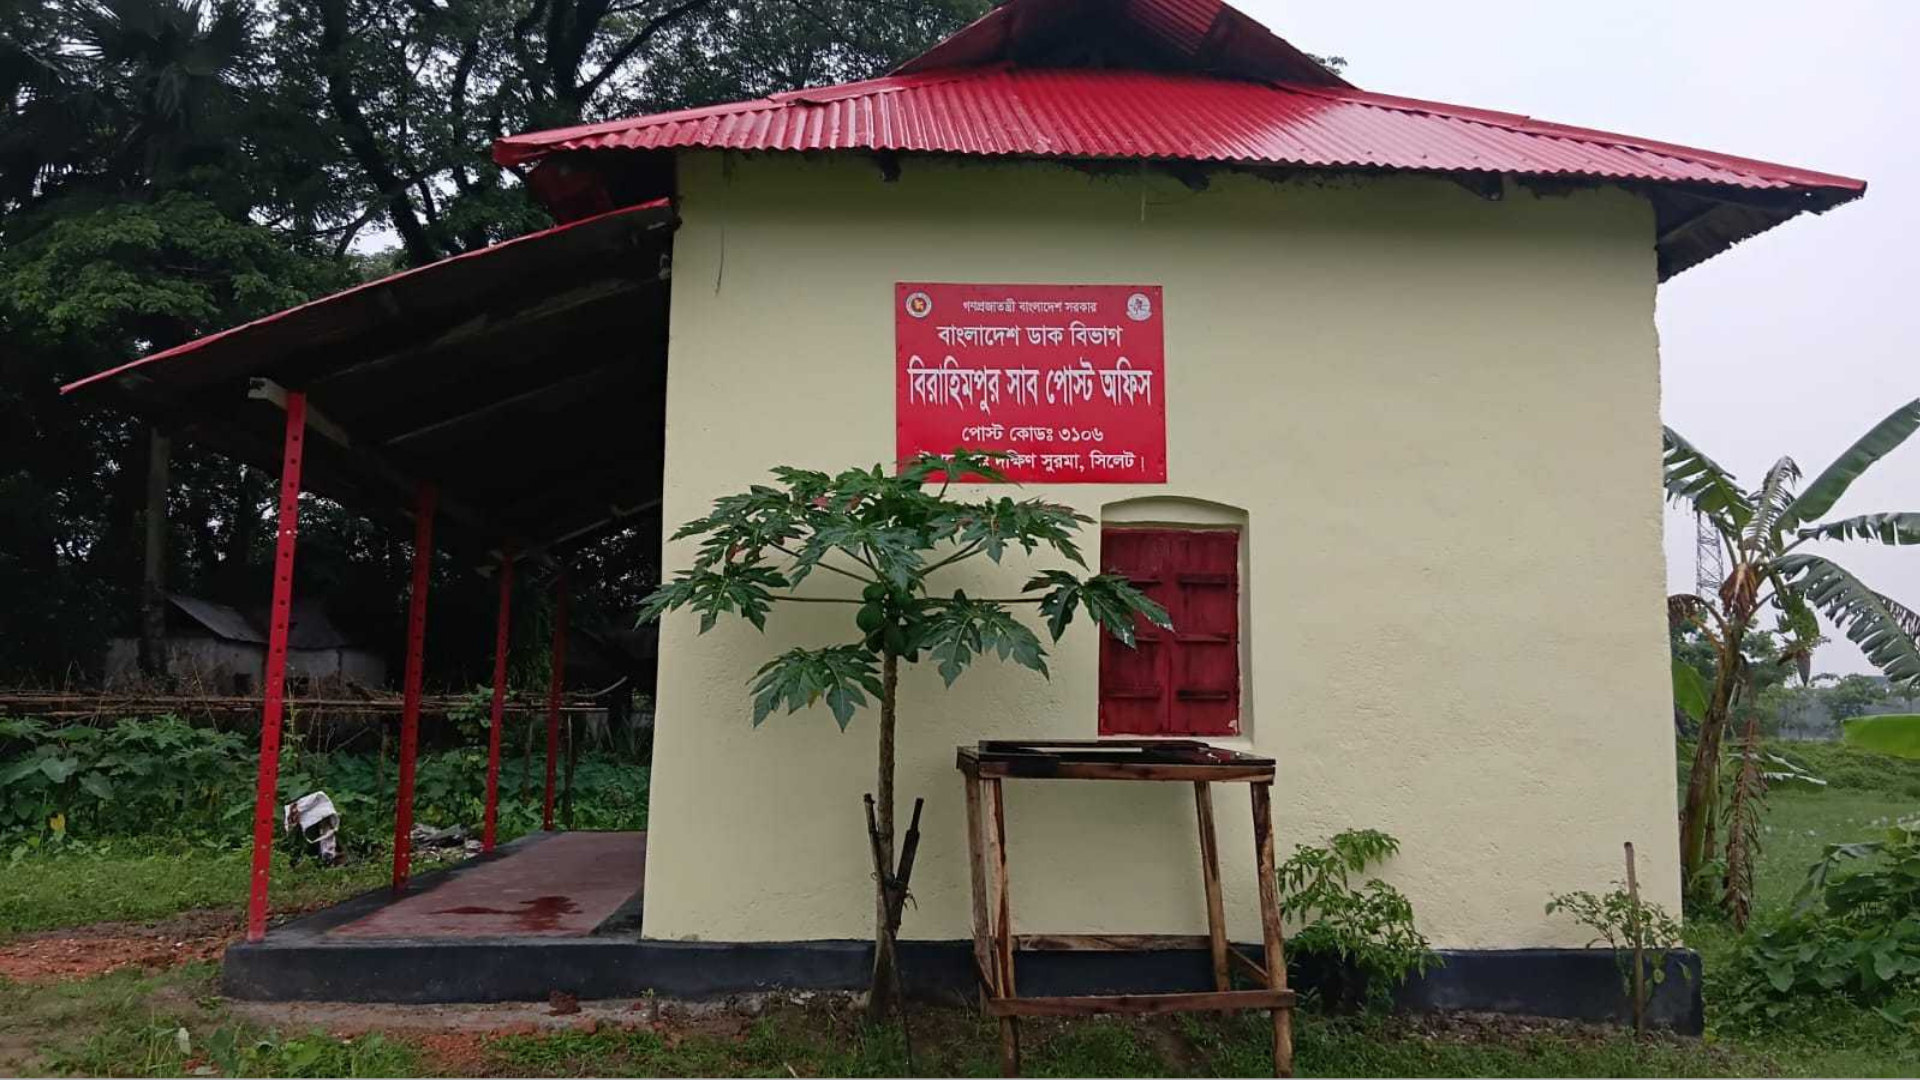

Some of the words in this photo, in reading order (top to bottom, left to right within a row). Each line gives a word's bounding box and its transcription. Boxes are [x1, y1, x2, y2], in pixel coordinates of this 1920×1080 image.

[1018, 301, 1062, 314] বাংলাদেশ
[1064, 301, 1097, 313] সরকার
[936, 324, 1021, 347] বাংলাদেশ
[1027, 325, 1065, 346] ডাক
[1069, 321, 1123, 347] বিভাগ
[907, 355, 1001, 415] বিরাহিমপুর
[1006, 364, 1040, 406] সাব
[1046, 356, 1096, 406] পোস্ট
[1099, 356, 1153, 406] অফিস
[962, 424, 1004, 442] পোস্ট
[1009, 427, 1053, 442] কোডঃ
[1058, 427, 1104, 442] ৩১০৬
[1041, 453, 1085, 473] সুরমা,
[1089, 450, 1136, 469] সিলেট
